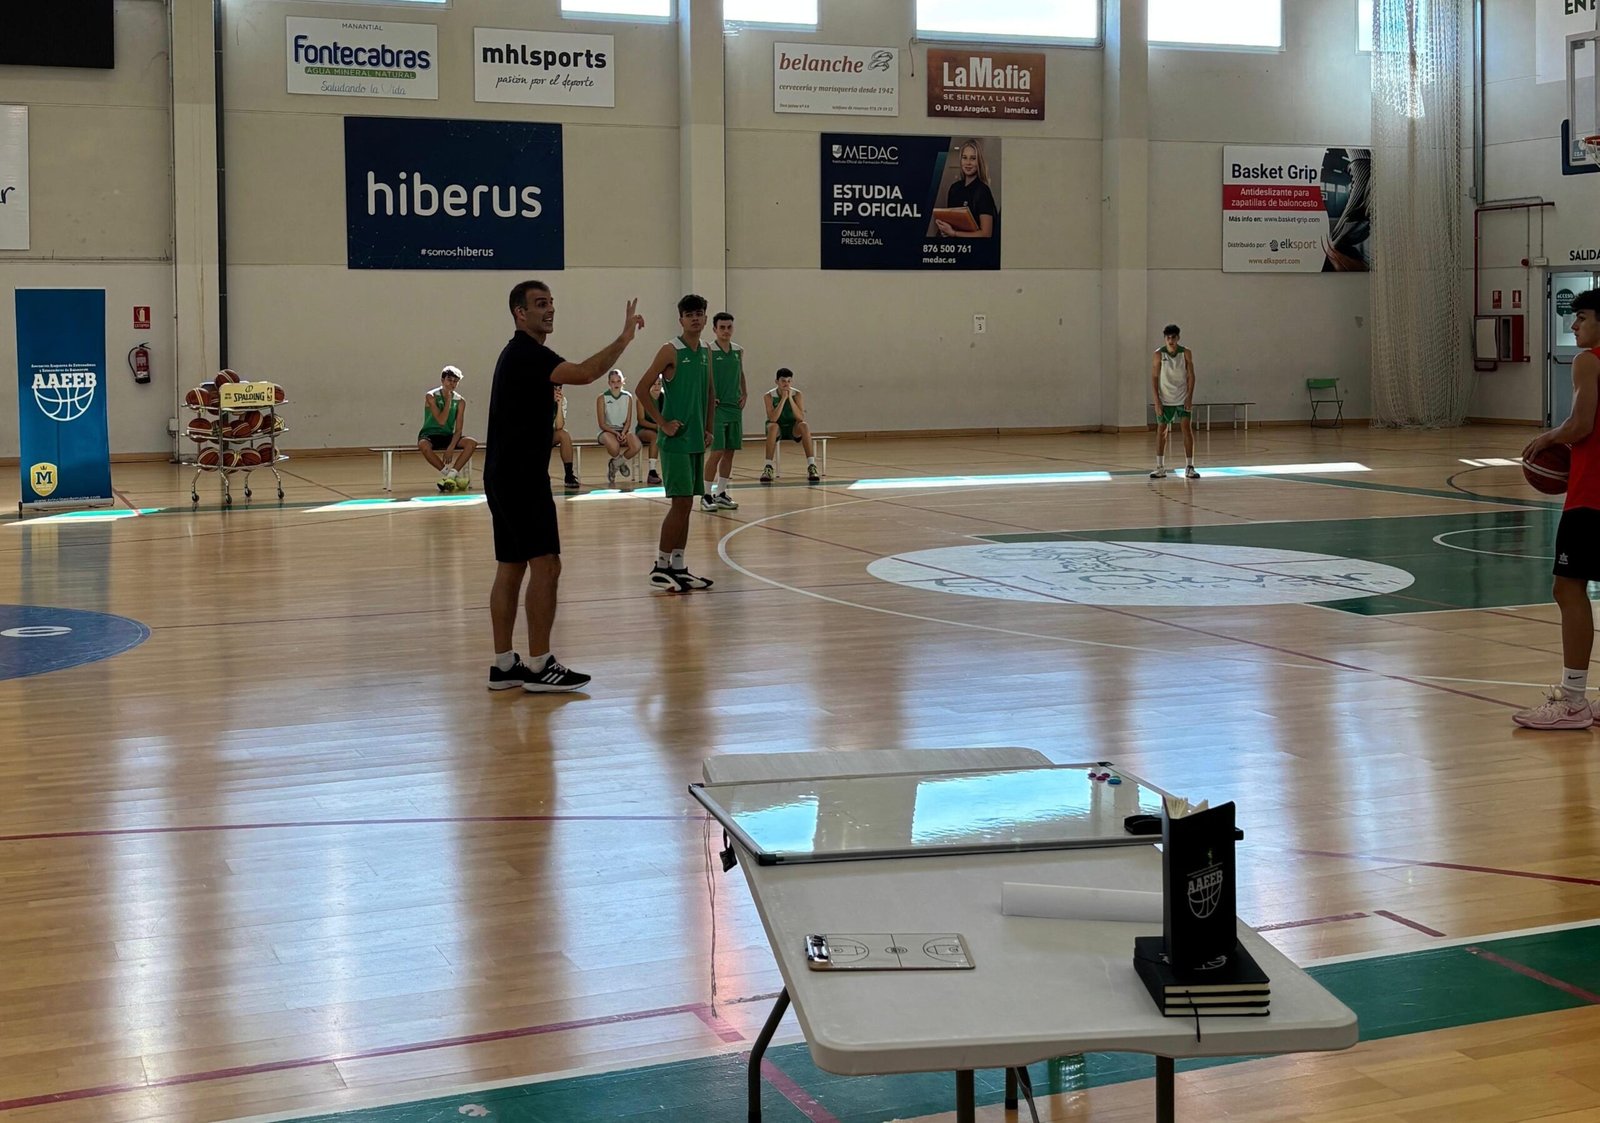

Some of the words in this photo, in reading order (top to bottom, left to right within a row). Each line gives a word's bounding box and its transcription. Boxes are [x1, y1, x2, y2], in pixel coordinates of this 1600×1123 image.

[342, 23, 384, 31] MANANTIAL
[294, 35, 431, 70] Fontecabras
[482, 44, 607, 71] mhlsports
[779, 52, 864, 73] belanche
[307, 67, 332, 76] AGUA
[334, 68, 372, 78] MINERAL
[375, 71, 415, 80] NATURAL
[321, 81, 366, 93] Saludando
[370, 83, 379, 94] la
[496, 75, 527, 88] pasión
[529, 77, 547, 90] por
[549, 74, 561, 86] el
[562, 74, 595, 92] deporte
[858, 86, 877, 94] desde
[956, 94, 986, 102] SIENTA
[943, 104, 963, 112] Plaza
[1004, 107, 1038, 115] lamafia.es
[843, 145, 899, 161] MEDAC
[1231, 163, 1283, 180] Basket
[1287, 165, 1318, 184] Grip
[367, 170, 542, 218] hiberus
[833, 184, 903, 200] ESTUDIA
[1240, 188, 1292, 197] Antideslizante
[1293, 190, 1310, 199] para
[1231, 198, 1267, 208] zapatillas
[1268, 199, 1278, 207] de
[1279, 199, 1318, 208] baloncesto
[833, 202, 854, 216] FP
[857, 203, 922, 218] OFICIAL
[1228, 215, 1241, 223] Más
[1242, 215, 1253, 223] info
[841, 229, 869, 237] ONLINE
[869, 230, 876, 238] Y
[841, 238, 884, 246] PRESENCIAL
[1280, 238, 1318, 252] elksport
[420, 246, 494, 257] #somoshiberus
[922, 245, 938, 253] 876
[940, 245, 955, 253] 500
[957, 245, 971, 253] 761
[922, 256, 956, 264] medac.es
[1248, 257, 1300, 267] www.elksport.com
[32, 372, 97, 389] AAEEB
[233, 392, 265, 403] SPALDING
[36, 471, 53, 485] M
[1187, 869, 1224, 895] AAEEB
